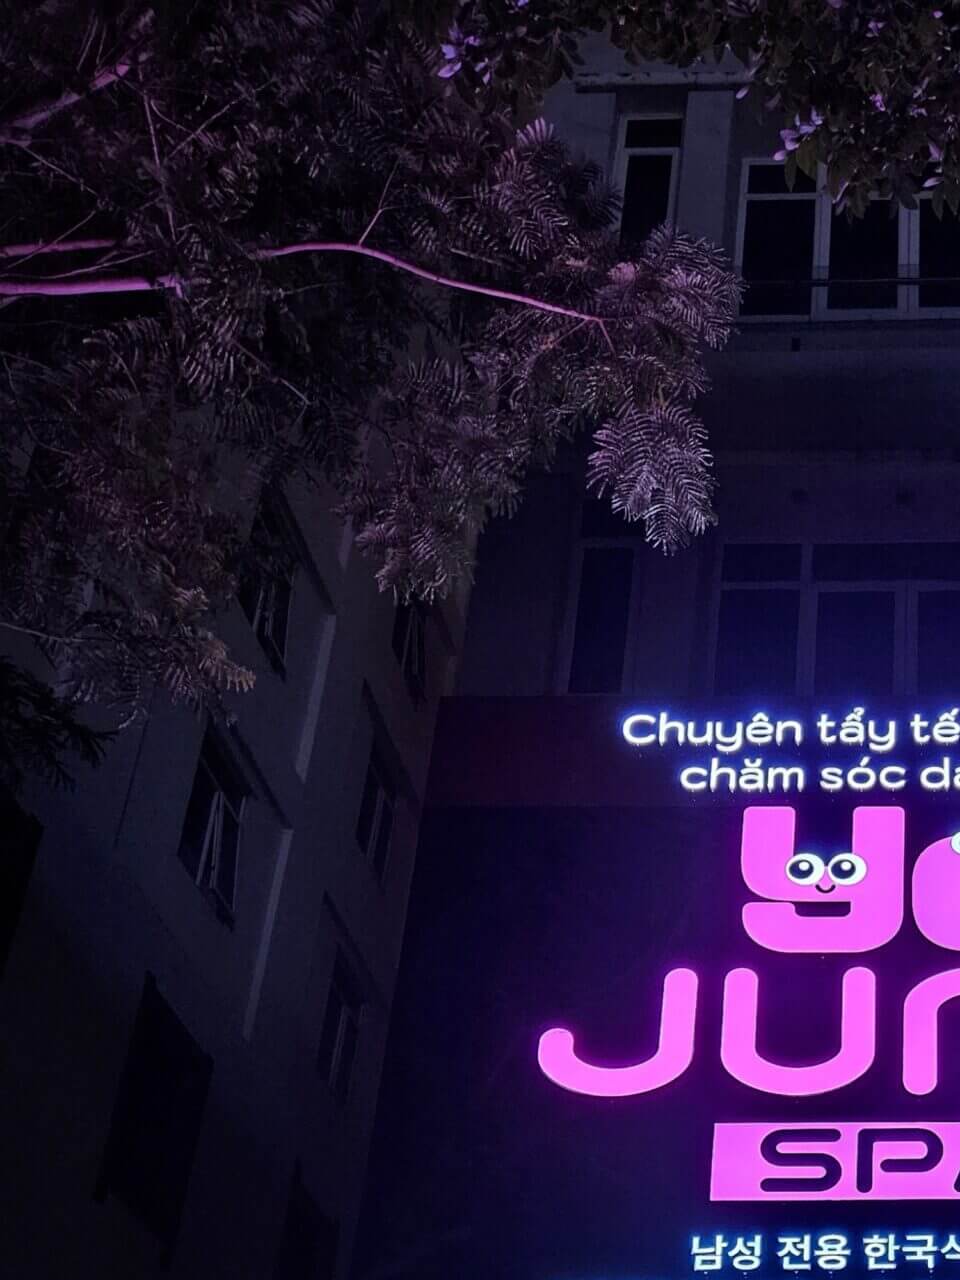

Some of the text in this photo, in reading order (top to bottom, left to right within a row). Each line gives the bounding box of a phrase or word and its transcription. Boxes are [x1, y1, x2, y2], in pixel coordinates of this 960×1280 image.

[622, 711, 802, 752] Chuyên
[816, 706, 896, 753] tẩy
[680, 757, 805, 792] chăm
[820, 757, 906, 792] sóc
[690, 1234, 762, 1270] 남성
[776, 1234, 852, 1270] 전용
